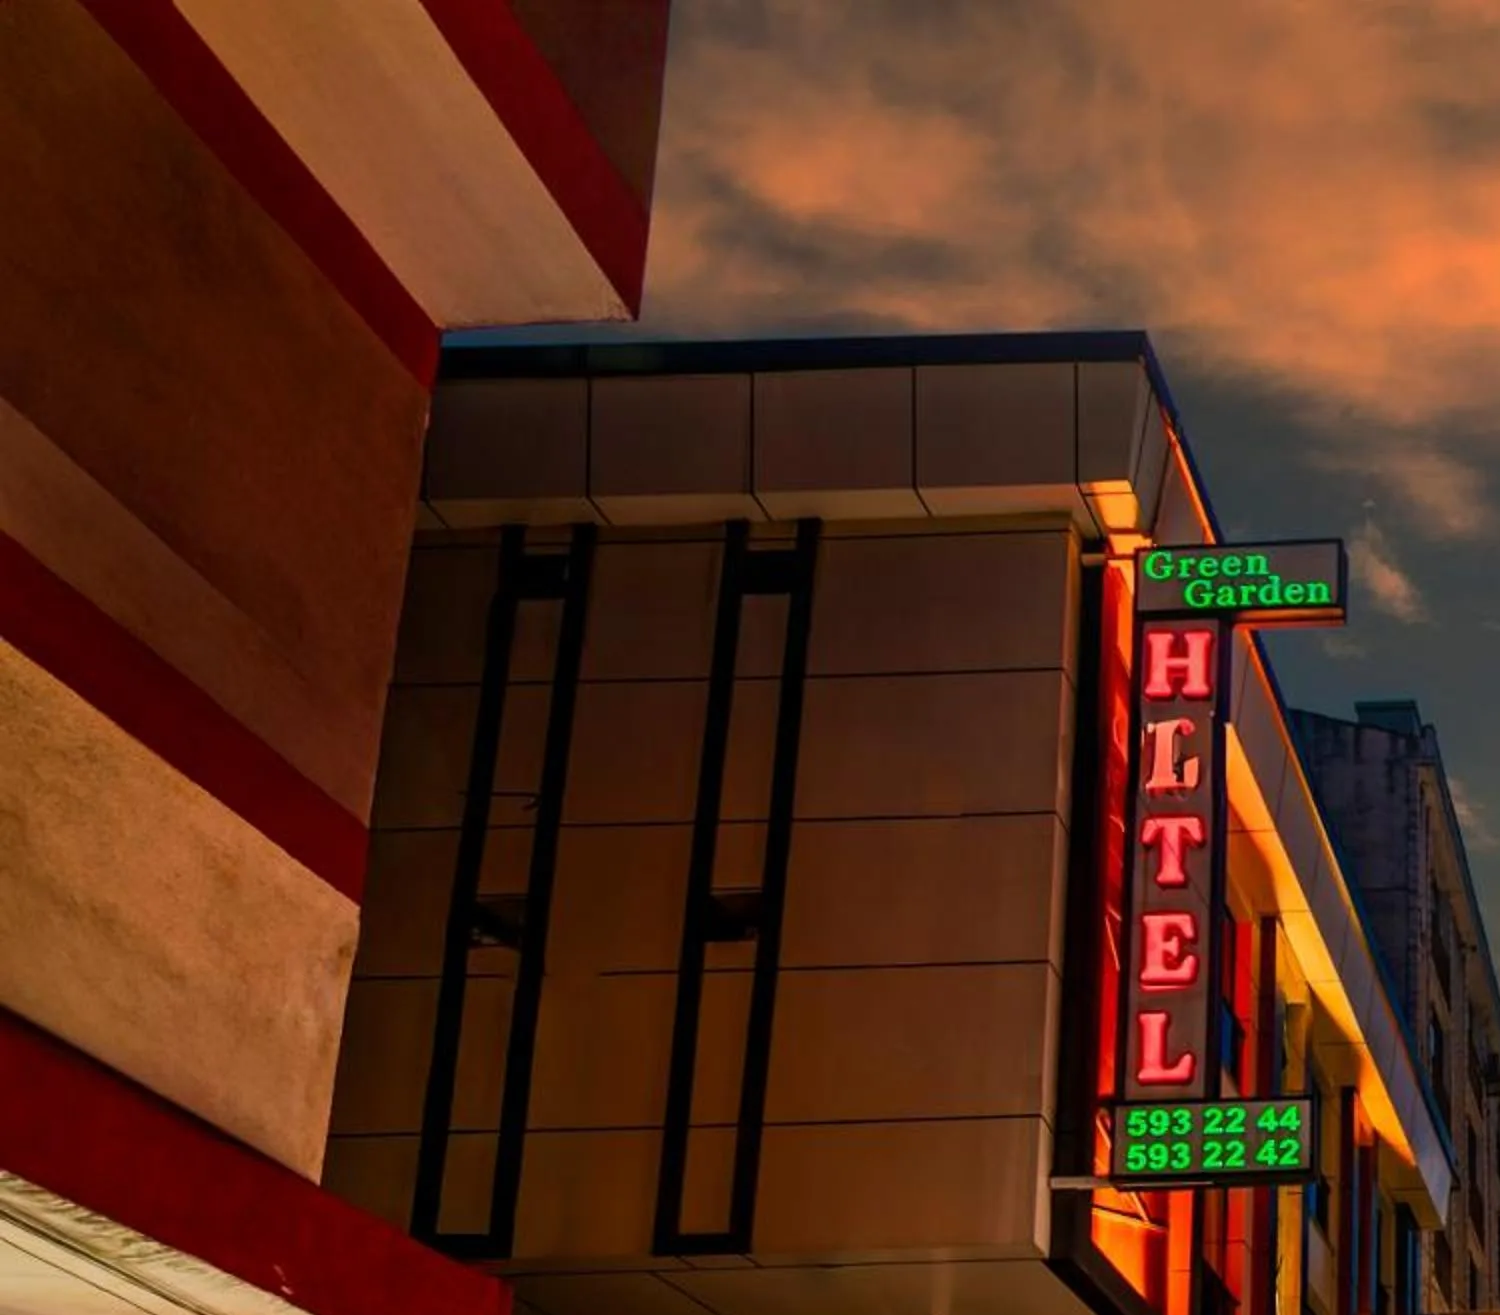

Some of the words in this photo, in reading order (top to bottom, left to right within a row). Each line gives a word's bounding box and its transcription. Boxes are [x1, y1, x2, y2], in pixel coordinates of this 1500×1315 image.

[1144, 551, 1270, 581] Green
[1184, 574, 1332, 608] Garden
[1126, 1108, 1192, 1137] 593
[1203, 1106, 1246, 1135] 22
[1257, 1105, 1300, 1132] 44
[1126, 1141, 1191, 1170] 593
[1203, 1140, 1245, 1168] 22
[1256, 1138, 1300, 1166] 42
